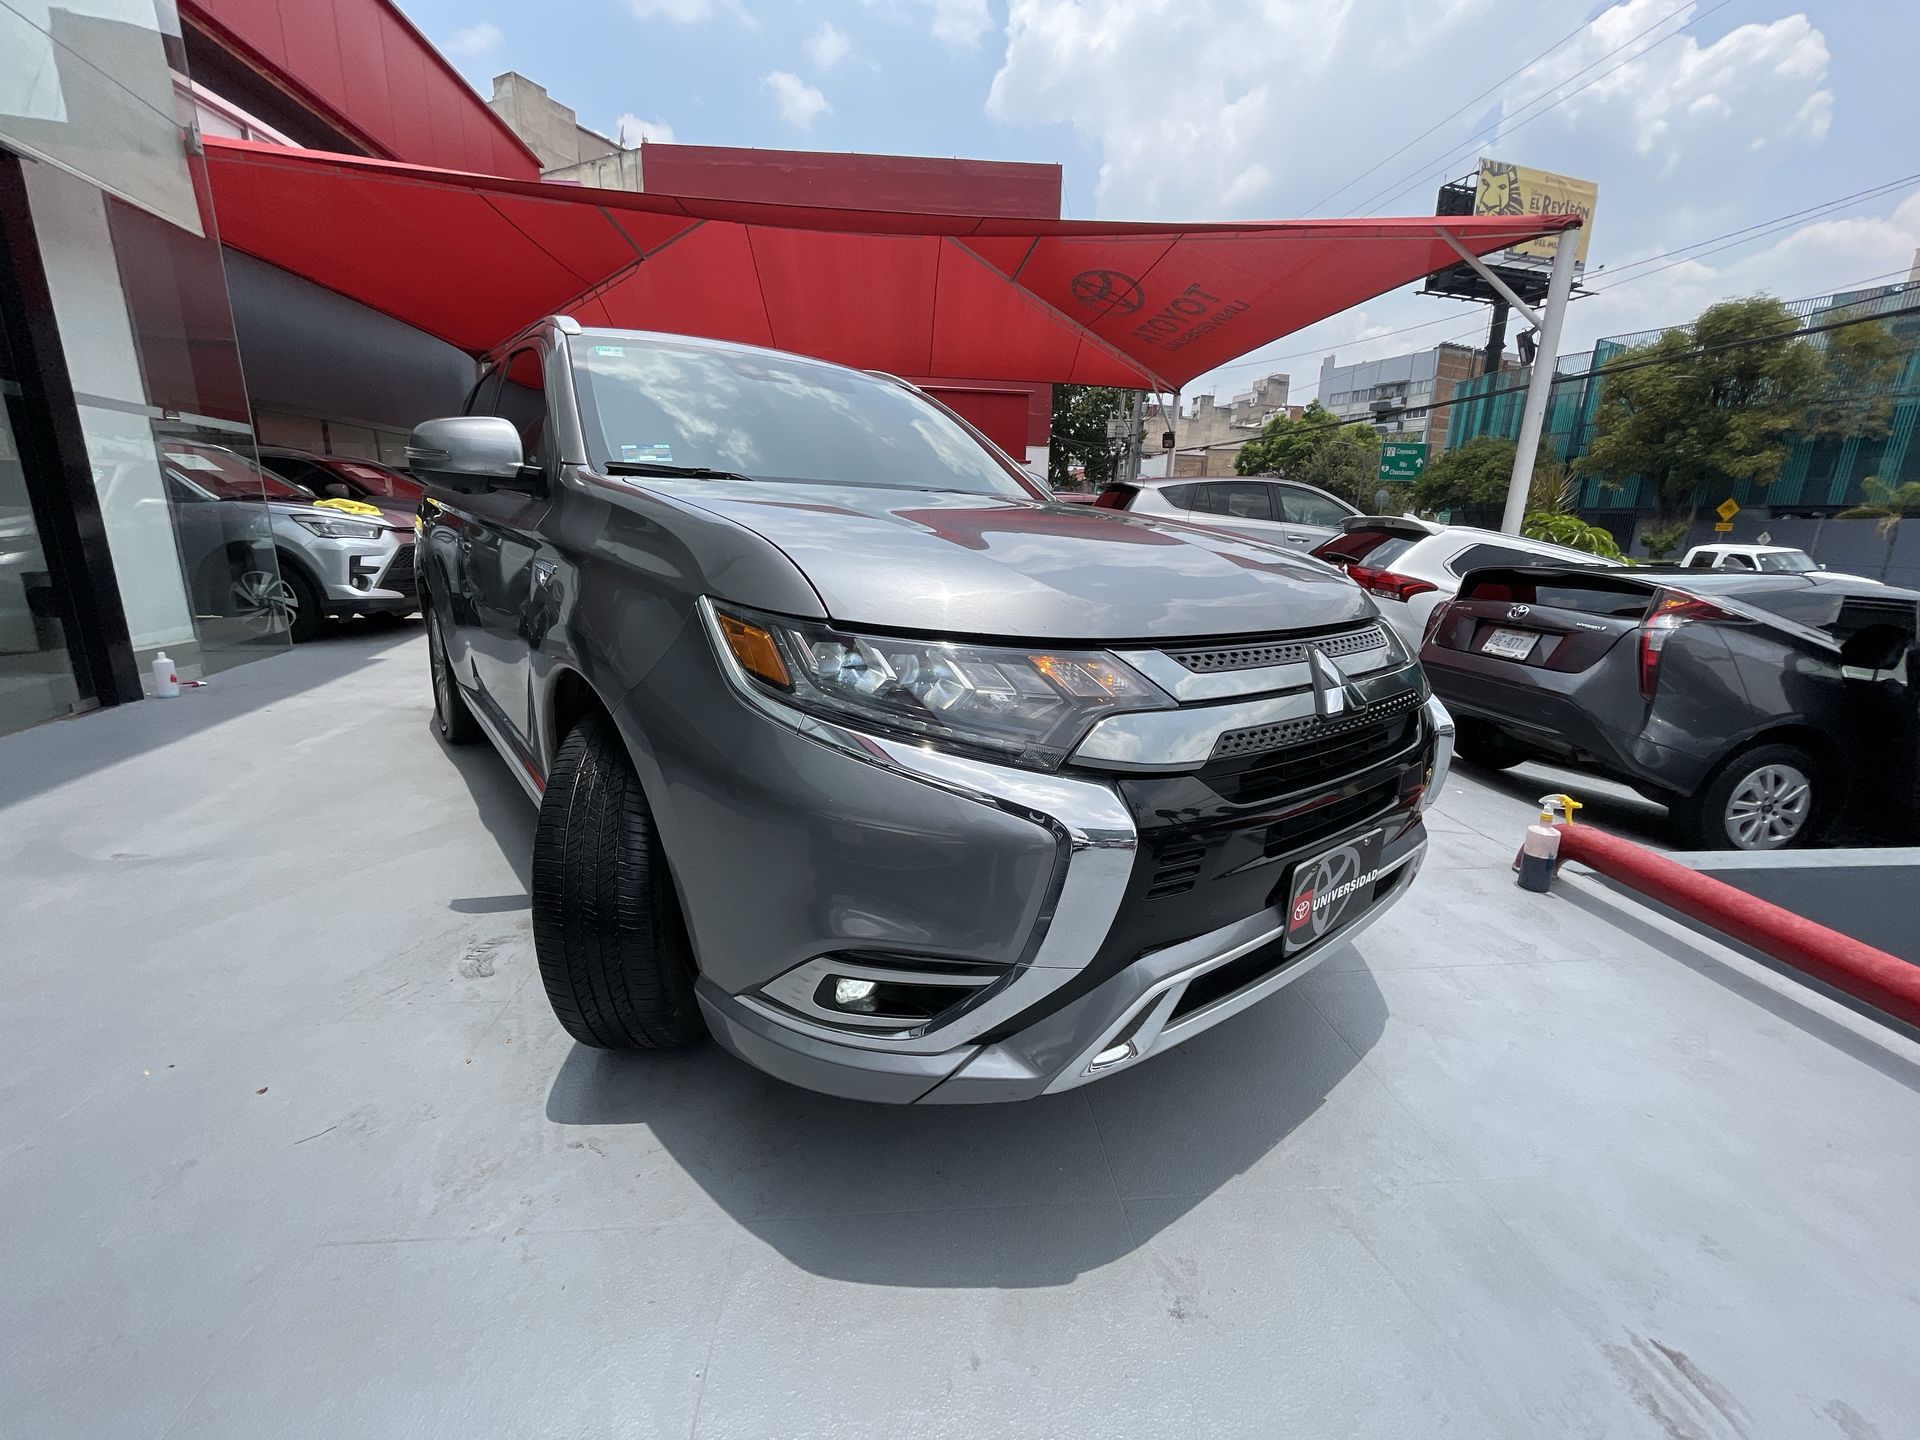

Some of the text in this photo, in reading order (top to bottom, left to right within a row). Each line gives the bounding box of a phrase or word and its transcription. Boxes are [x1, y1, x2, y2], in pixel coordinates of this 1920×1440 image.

[1530, 197, 1540, 211] EL
[1541, 194, 1565, 216] REY
[1312, 868, 1378, 912] UNIVERSIDAD
